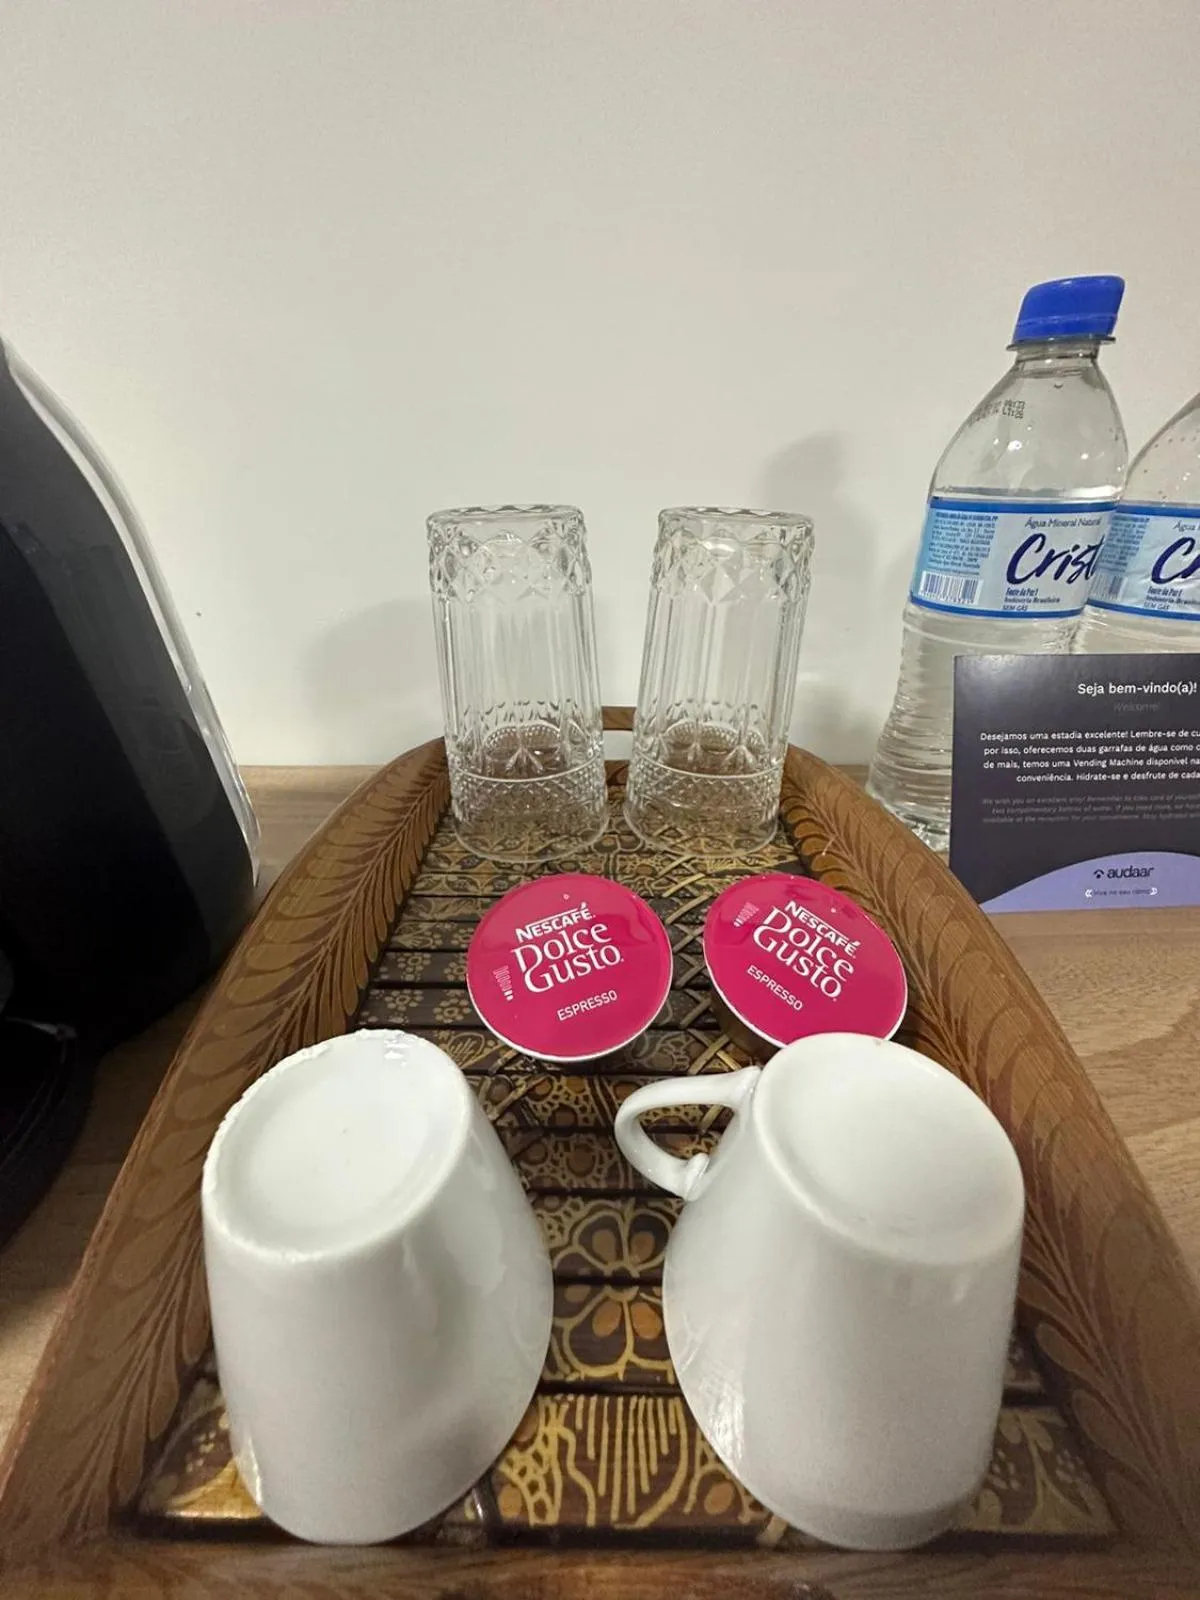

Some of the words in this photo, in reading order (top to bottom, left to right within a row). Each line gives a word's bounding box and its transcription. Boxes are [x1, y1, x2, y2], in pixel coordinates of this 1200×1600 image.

[1048, 517, 1077, 528] Mineral
[1078, 682, 1105, 697] Seja
[1108, 681, 1198, 696] bem-vindo(a)!
[980, 732, 1027, 742] Desejamos
[1051, 731, 1082, 740] estadia
[1084, 730, 1128, 739] excelente!
[1130, 729, 1176, 738] Lembre-se
[1178, 728, 1188, 737] de
[983, 747, 998, 756] por
[1001, 746, 1021, 755] isso,
[1023, 744, 1074, 754] oferecemos
[1076, 744, 1096, 753] duas
[1099, 744, 1133, 755] garrafas
[1135, 743, 1146, 752] de
[1148, 743, 1168, 754] água
[983, 760, 994, 769] de
[997, 759, 1020, 769] mais,
[1022, 760, 1049, 768] temos
[1052, 760, 1071, 768] uma
[1073, 758, 1107, 769] Vending
[1109, 757, 1144, 766] Machine
[1076, 771, 1121, 781] Hidrate-se
[1131, 771, 1166, 780] desfrute
[1168, 771, 1179, 779] de
[1181, 770, 1200, 779] cada
[1107, 865, 1154, 879] audaar
[511, 922, 612, 973] Dolce
[762, 905, 854, 982] Dolce
[746, 965, 804, 1011] ESPRESSO
[557, 989, 618, 1021] ESPRESSO
